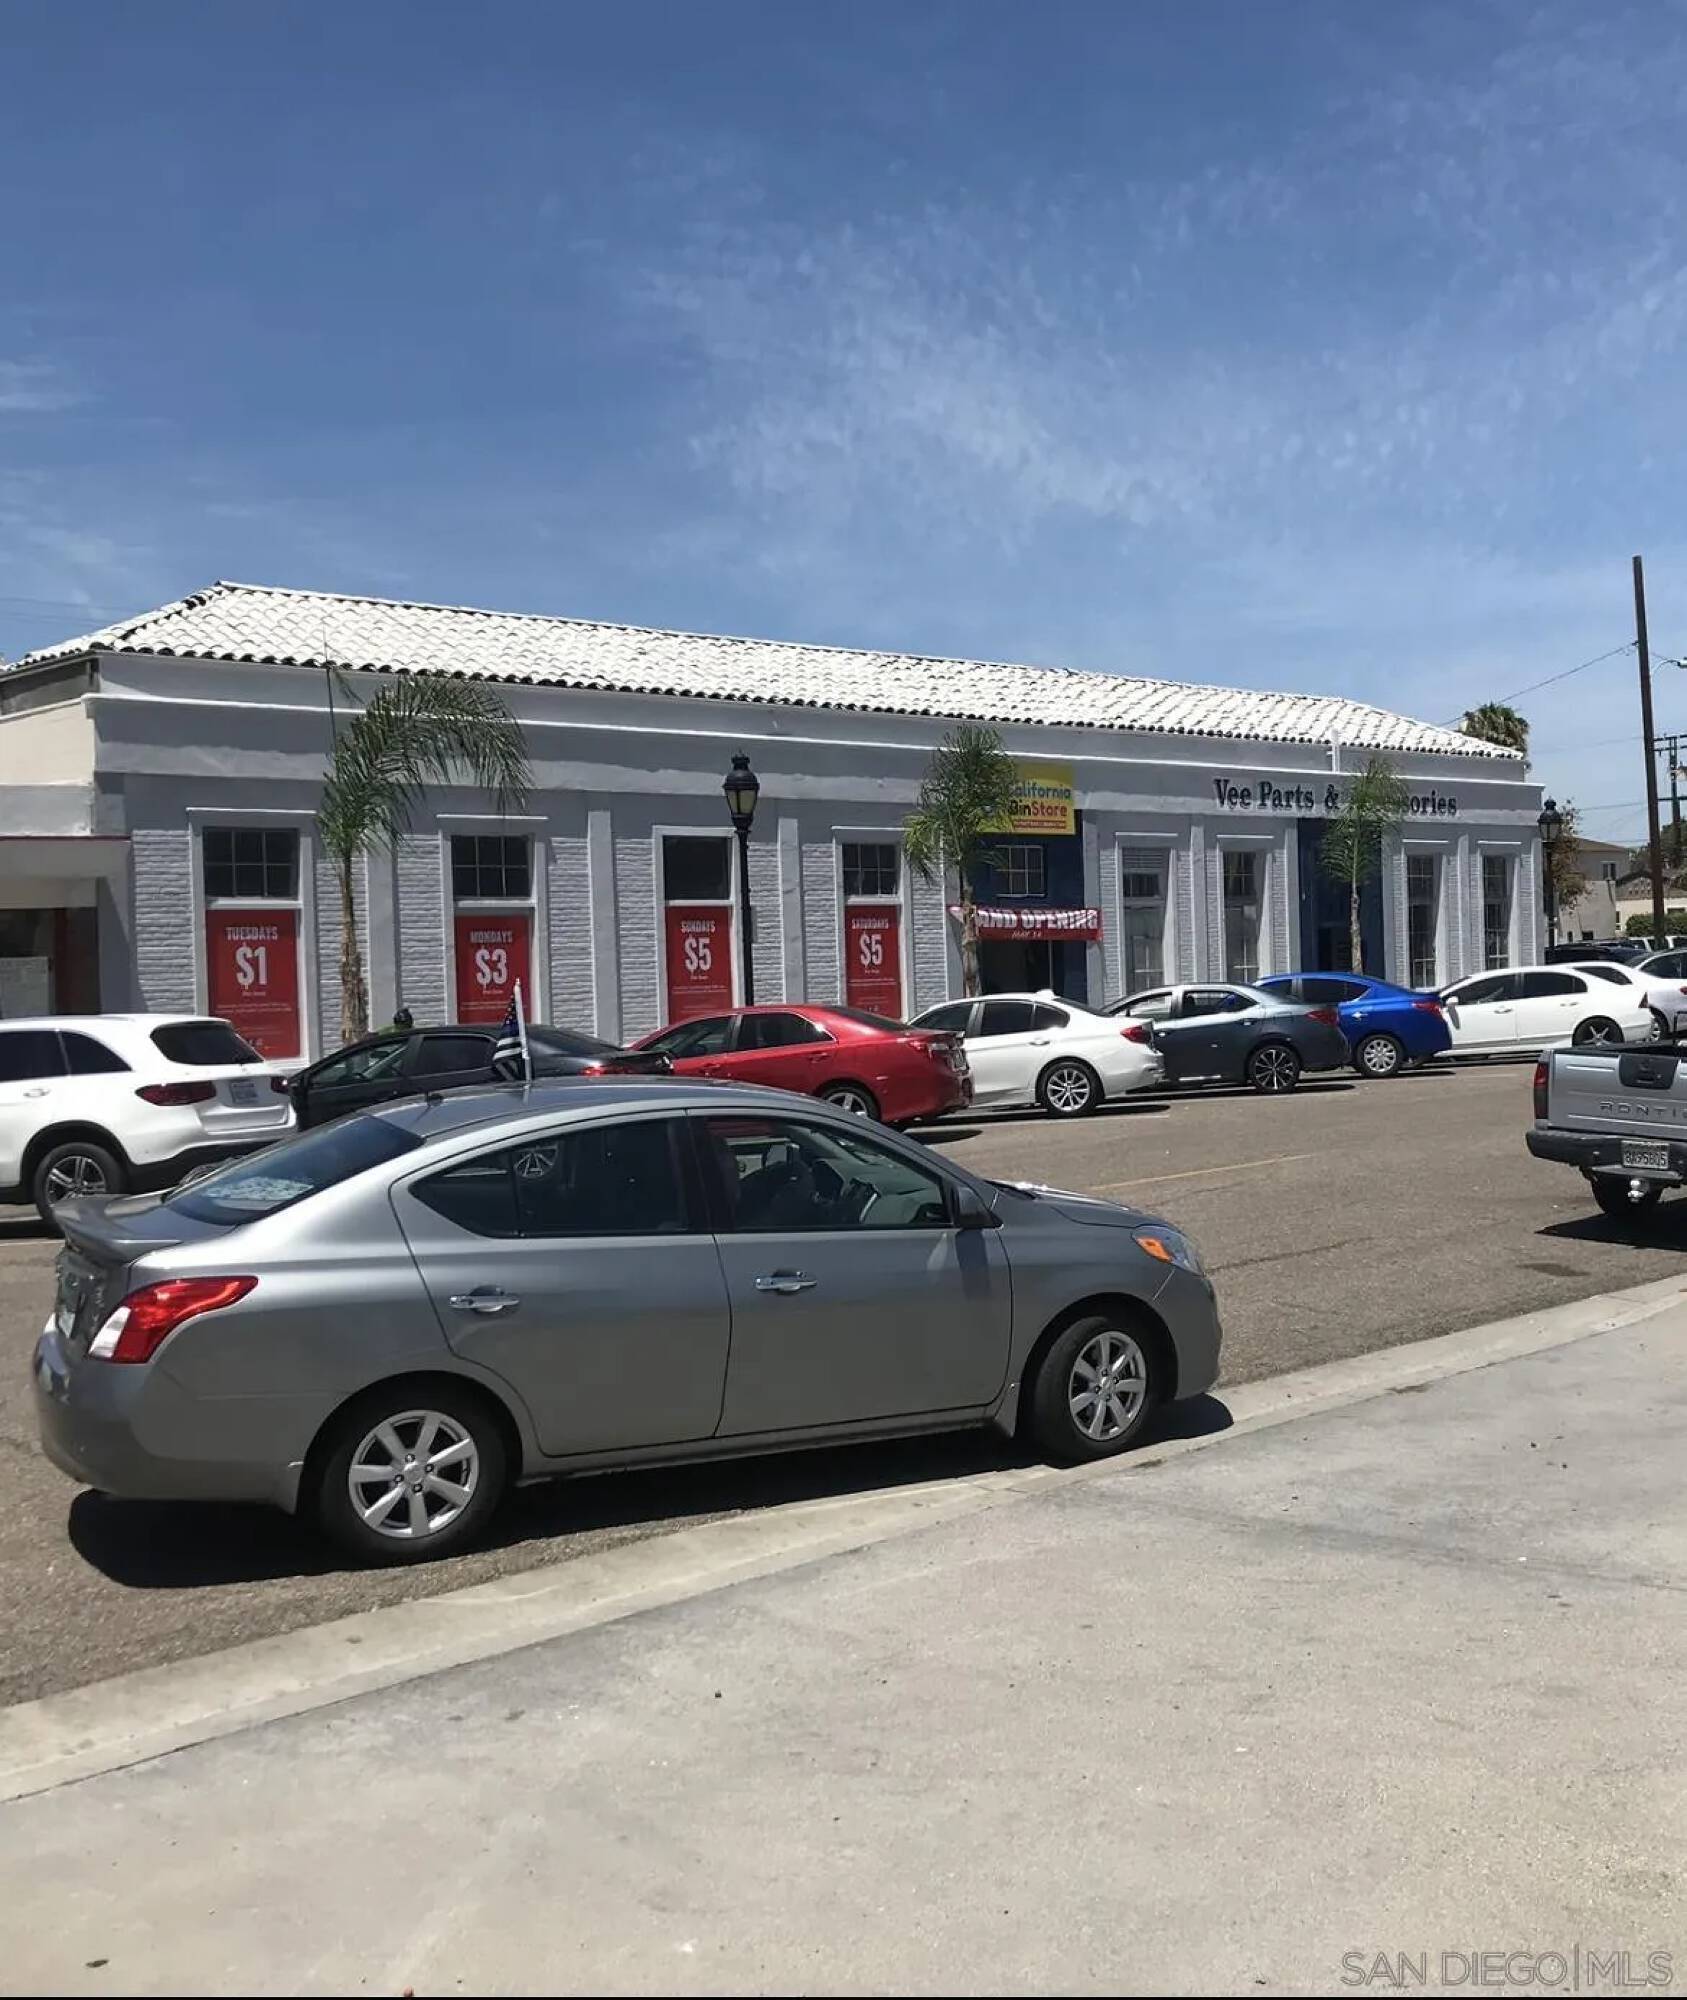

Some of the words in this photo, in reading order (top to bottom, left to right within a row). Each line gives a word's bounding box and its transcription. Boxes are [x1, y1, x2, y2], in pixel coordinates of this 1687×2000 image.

[1010, 780, 1072, 799] alifornia
[1213, 779, 1251, 807] Vee
[1258, 781, 1314, 810] Parts
[1324, 784, 1340, 810] &
[681, 920, 716, 933] SUNDAYS
[1021, 909, 1099, 930] OPENING
[226, 926, 279, 941] TUESDAYS
[469, 930, 513, 944] MONDAYS
[684, 934, 712, 973] $5
[860, 931, 883, 968] $5
[235, 941, 268, 990] $1
[475, 945, 508, 990] $3
